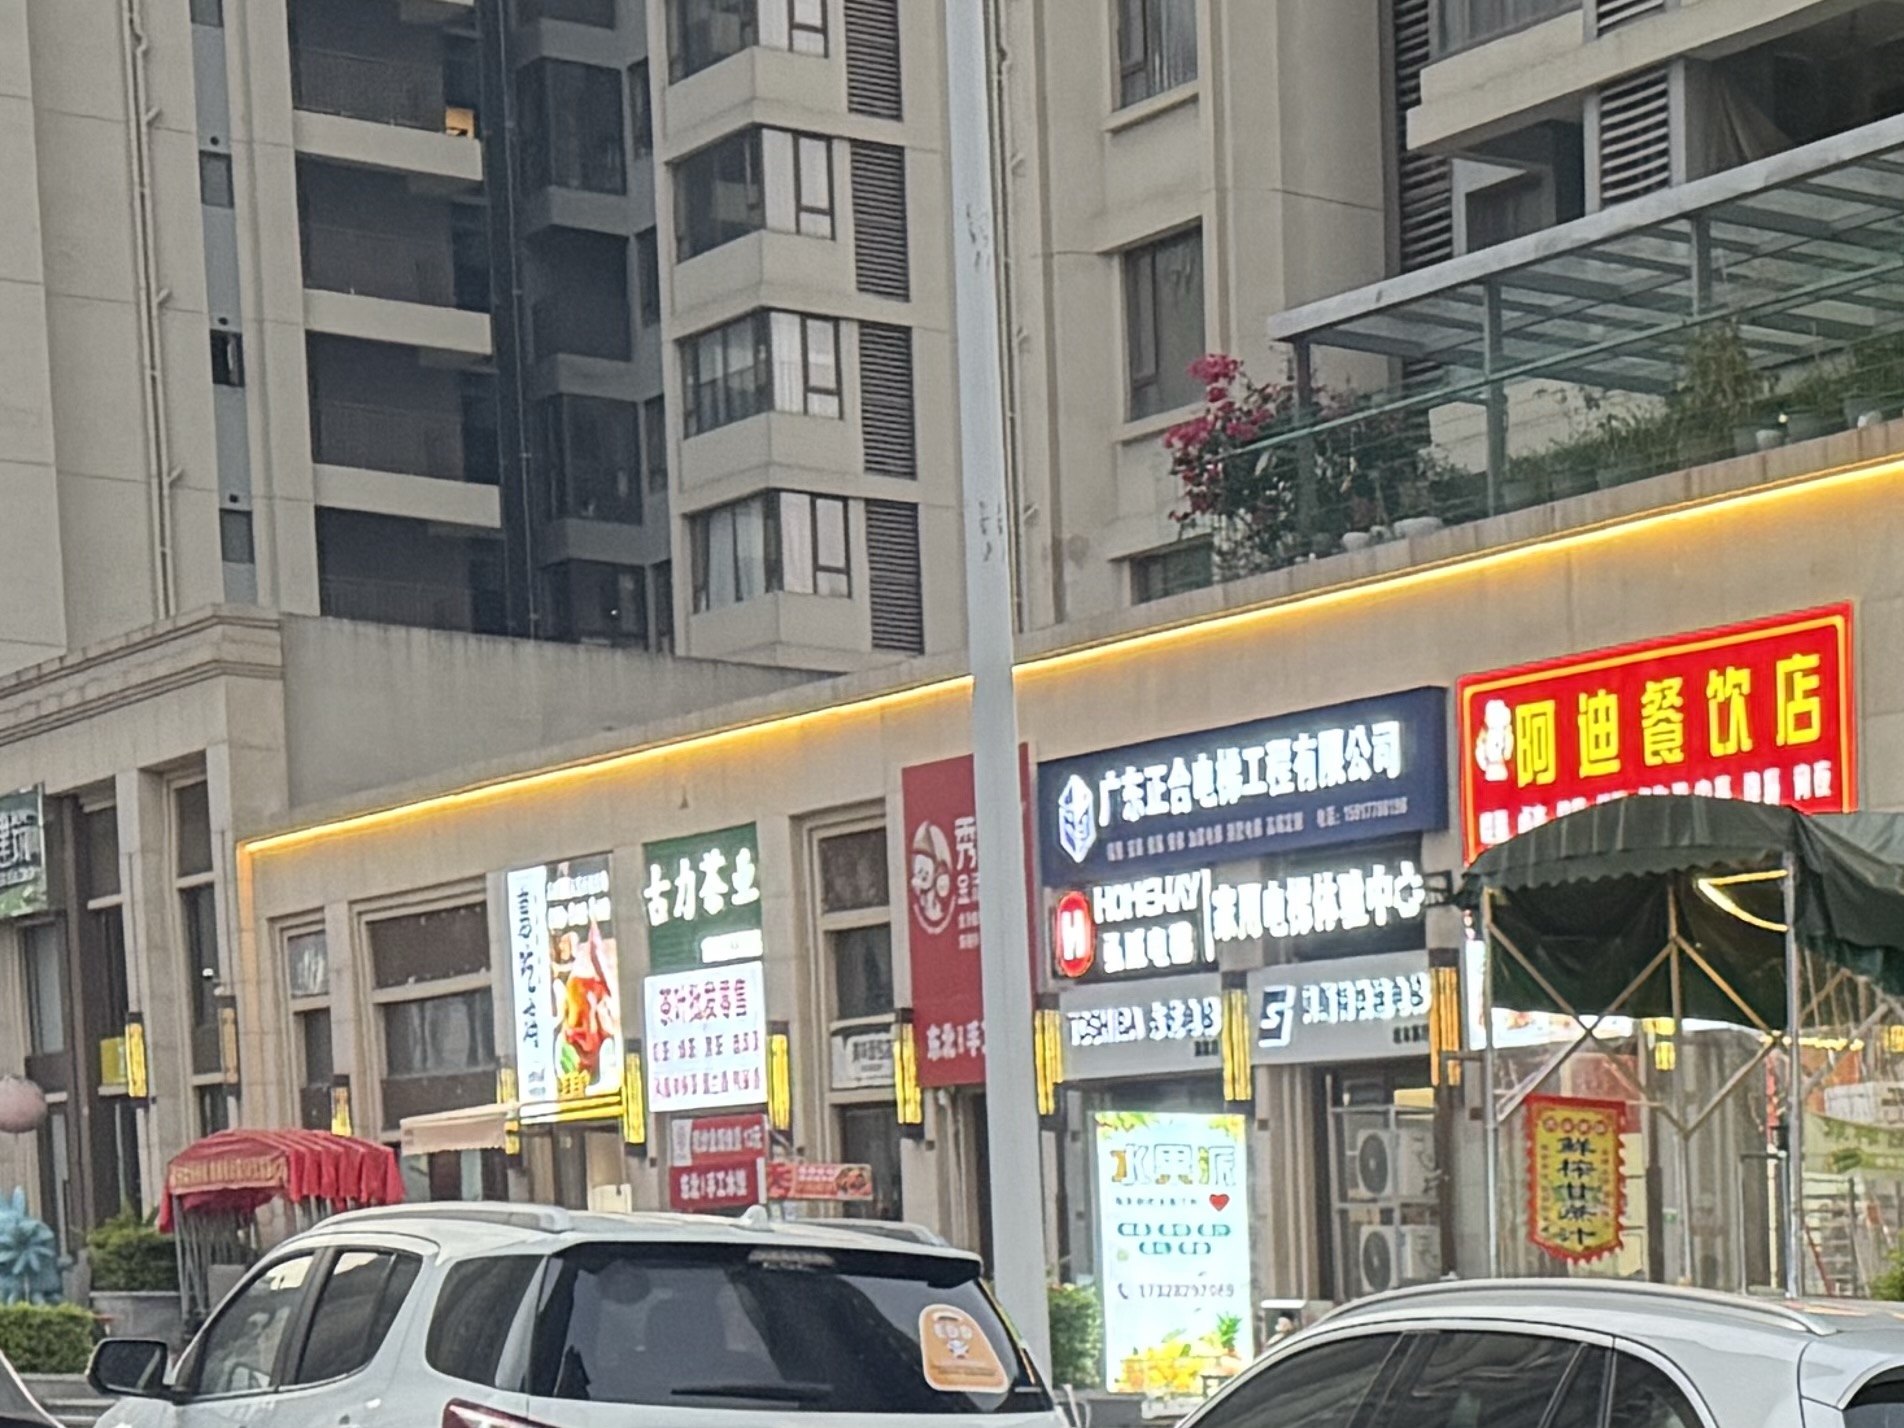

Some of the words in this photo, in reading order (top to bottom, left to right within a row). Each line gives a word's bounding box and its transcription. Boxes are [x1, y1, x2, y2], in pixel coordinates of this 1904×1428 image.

[1515, 653, 1822, 788] 阿迪餐饮店
[1110, 1143, 1237, 1187] 水果派
